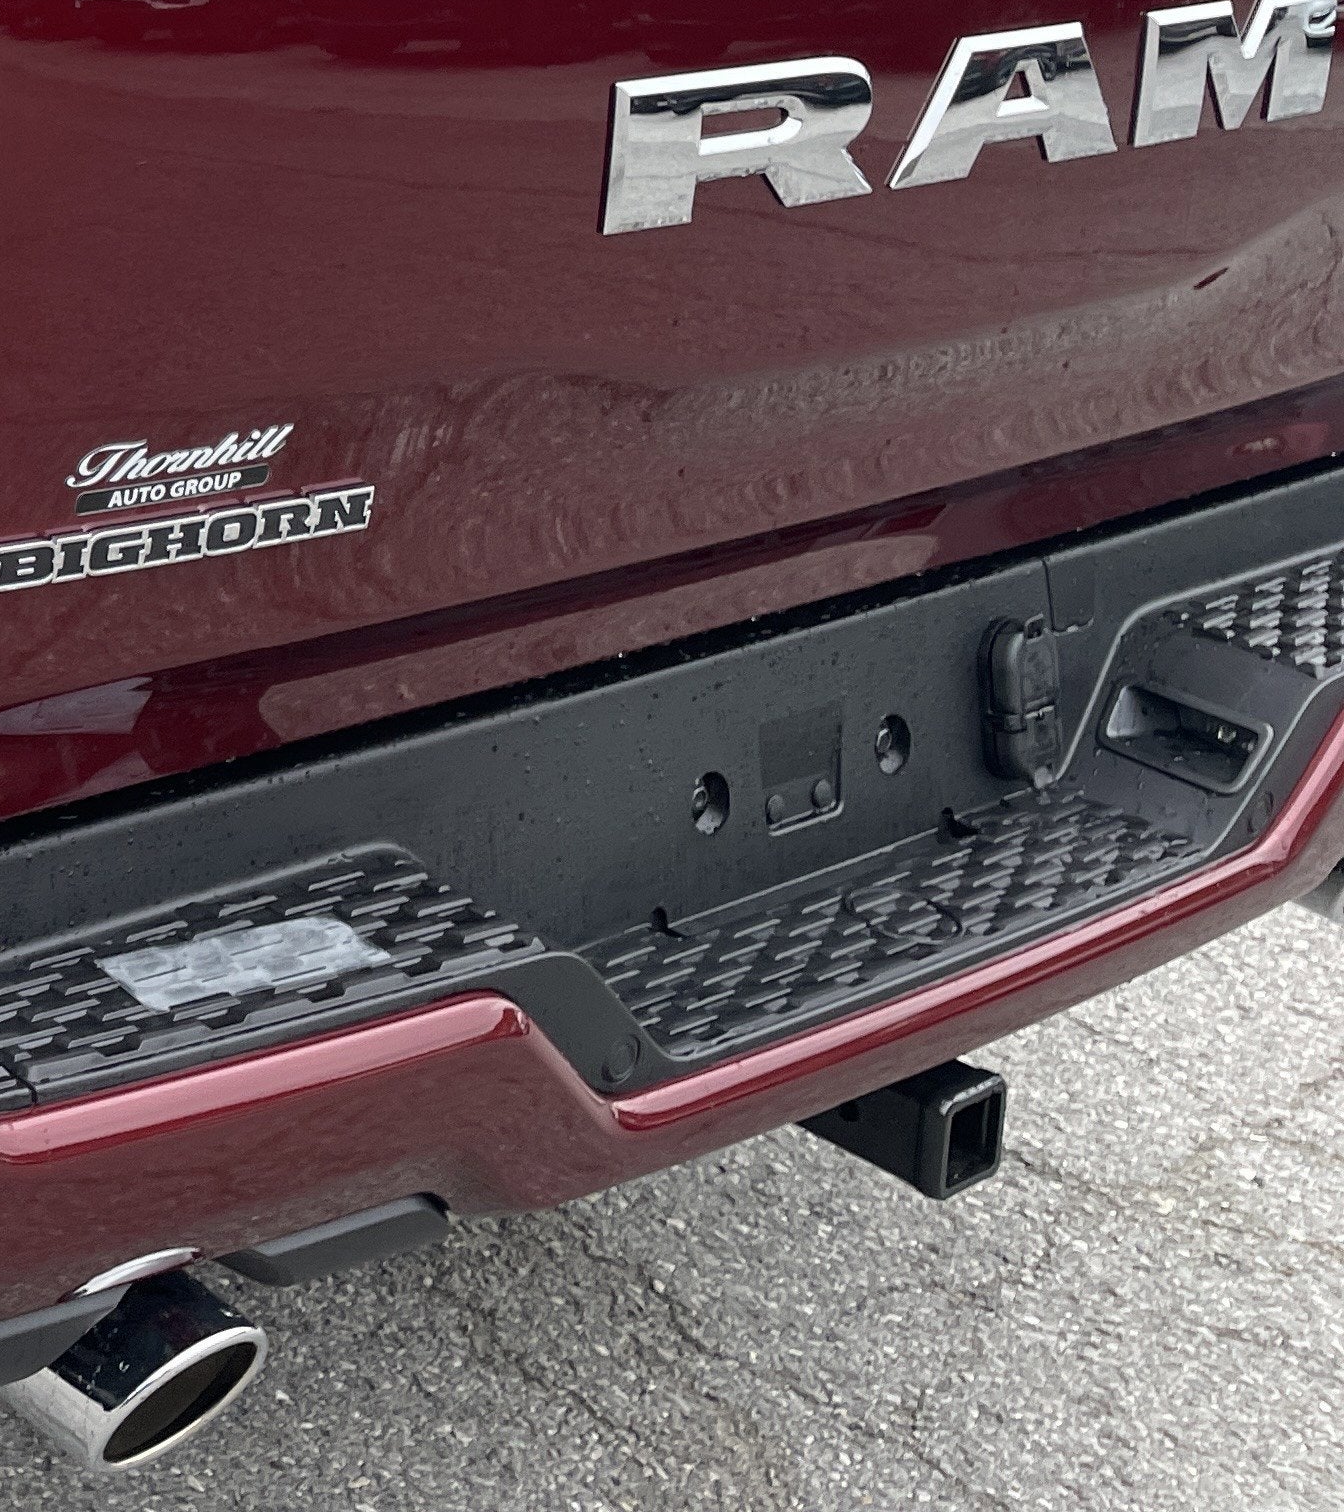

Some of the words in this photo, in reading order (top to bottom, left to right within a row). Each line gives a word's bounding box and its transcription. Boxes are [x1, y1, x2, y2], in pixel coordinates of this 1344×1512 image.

[65, 422, 296, 489] Thornhill
[107, 485, 167, 509] AUTO
[169, 470, 243, 498] GROUP
